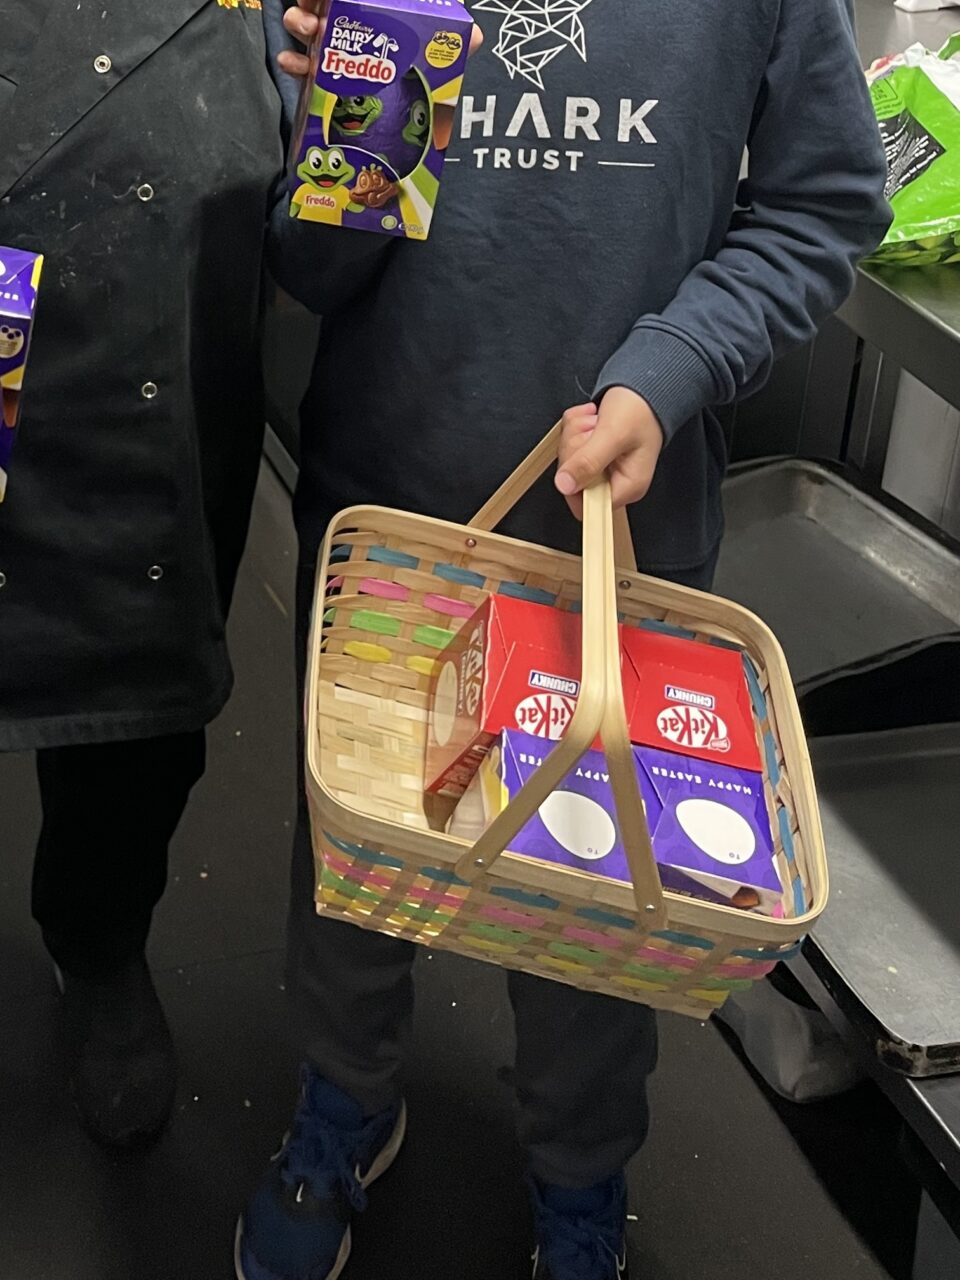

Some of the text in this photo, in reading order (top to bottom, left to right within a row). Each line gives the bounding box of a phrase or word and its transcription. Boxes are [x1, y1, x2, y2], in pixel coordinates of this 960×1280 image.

[330, 38, 364, 54] MILK
[332, 27, 375, 45] DAIRY
[326, 51, 392, 81] Freddo
[460, 92, 659, 144] HARK
[473, 147, 584, 171] TRUST
[306, 195, 335, 208] Freddo
[531, 673, 576, 694] CHUNKY
[668, 687, 712, 707] CHUNKY
[660, 708, 720, 746] KitKat
[576, 767, 610, 783] APPY
[652, 766, 752, 795] HAPPY EASTER
